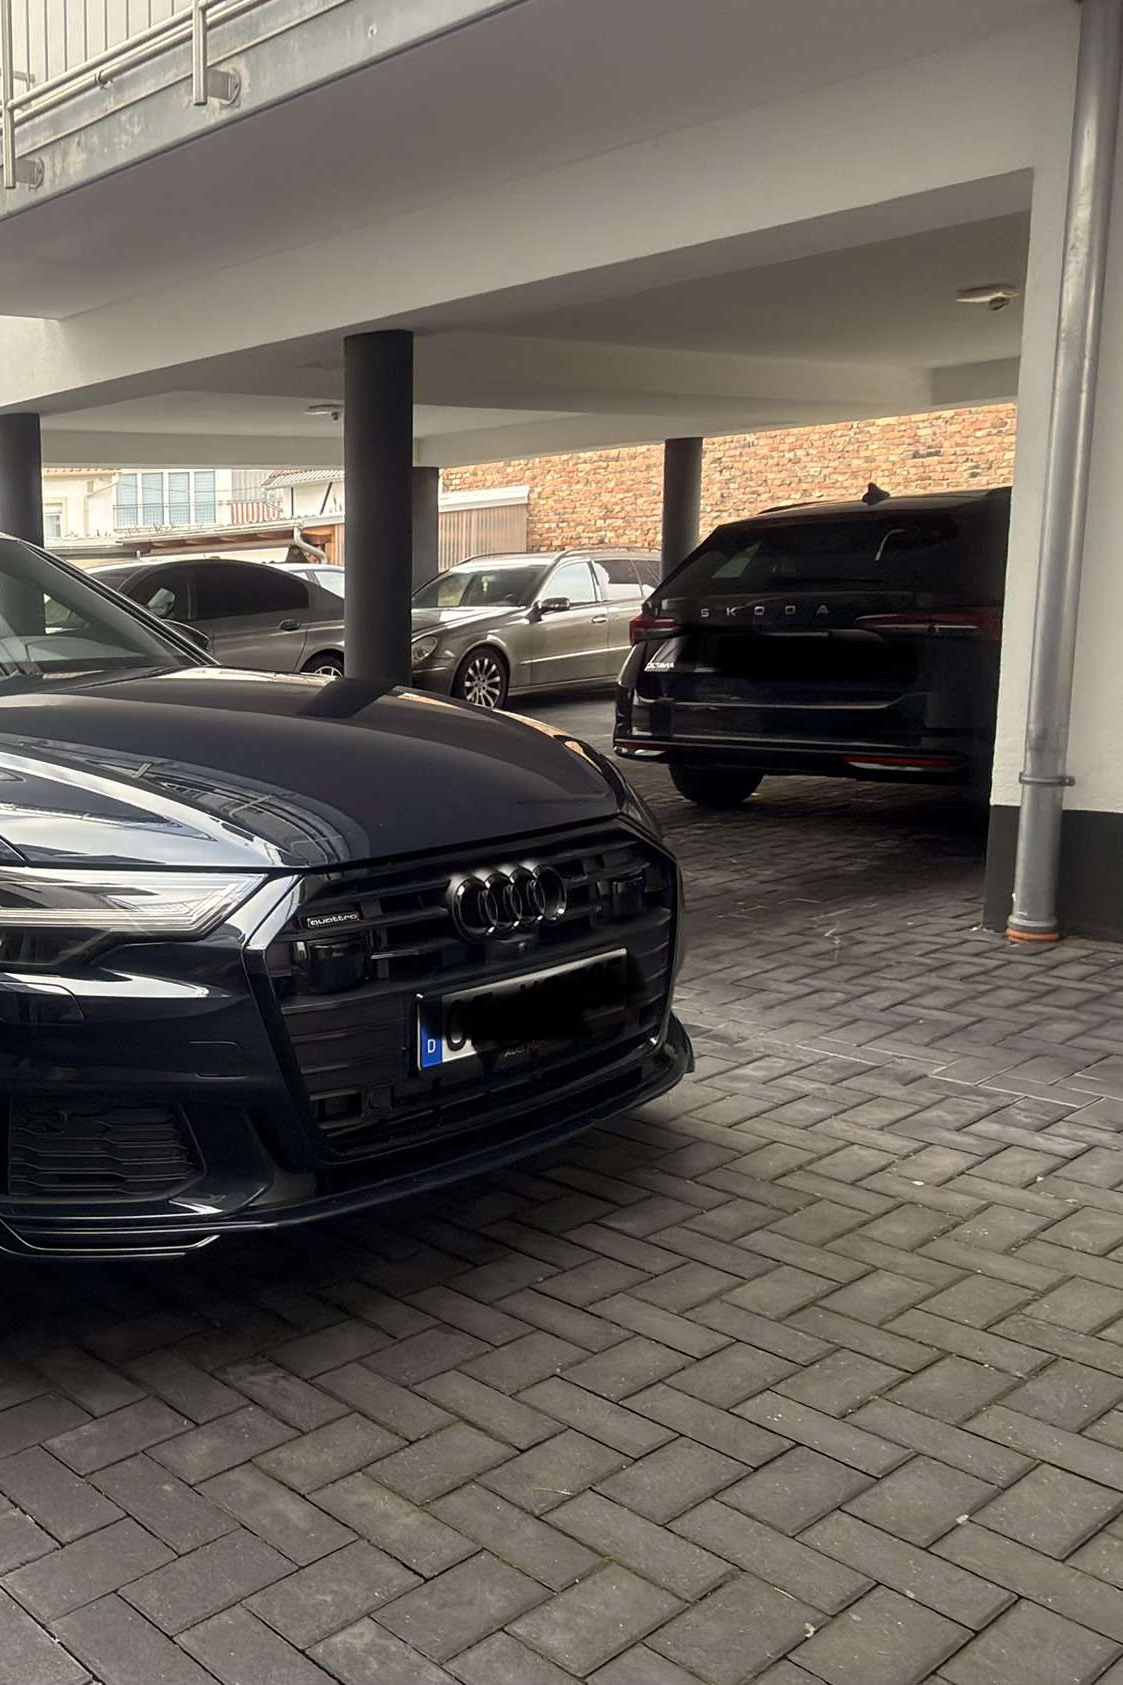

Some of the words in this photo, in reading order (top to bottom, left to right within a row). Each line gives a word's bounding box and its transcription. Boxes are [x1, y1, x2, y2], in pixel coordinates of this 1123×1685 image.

[700, 604, 829, 618] SKODA
[309, 913, 358, 927] quattro
[427, 1038, 437, 1054] D
